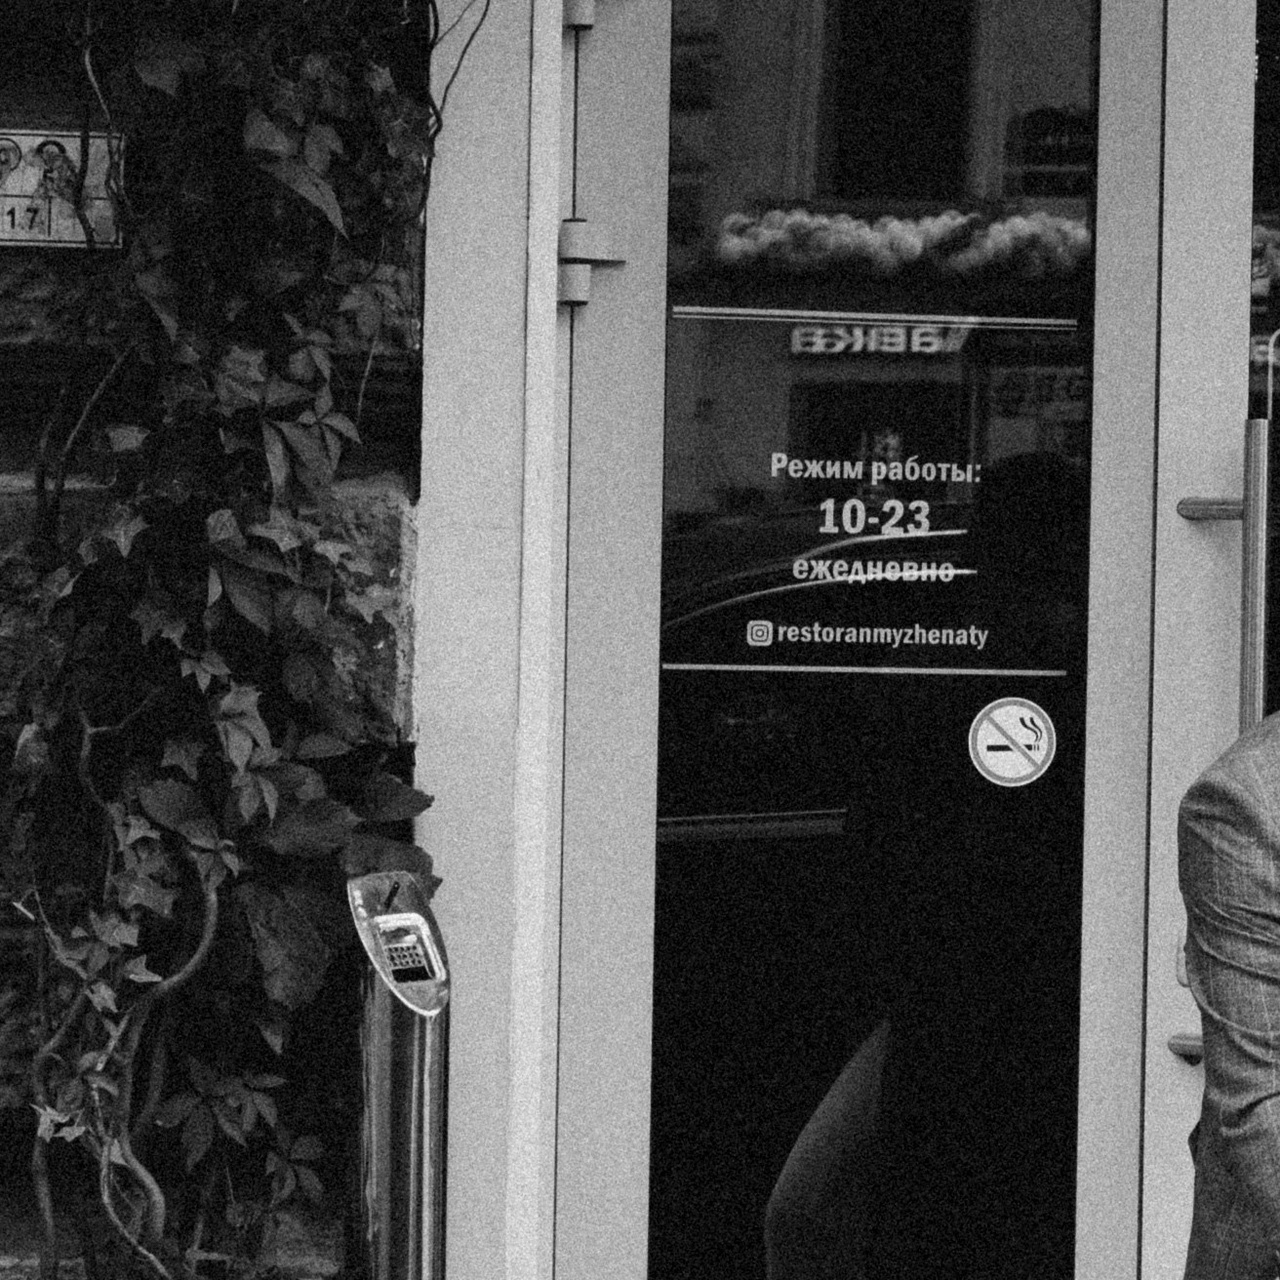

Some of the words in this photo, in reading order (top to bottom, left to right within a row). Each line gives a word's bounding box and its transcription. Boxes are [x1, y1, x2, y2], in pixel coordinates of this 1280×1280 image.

[770, 452, 863, 480] Режим
[871, 455, 983, 485] работы:
[817, 497, 931, 537] 10-23
[792, 556, 956, 586] ежедневно
[777, 623, 989, 651] restoranmyzhenaty
